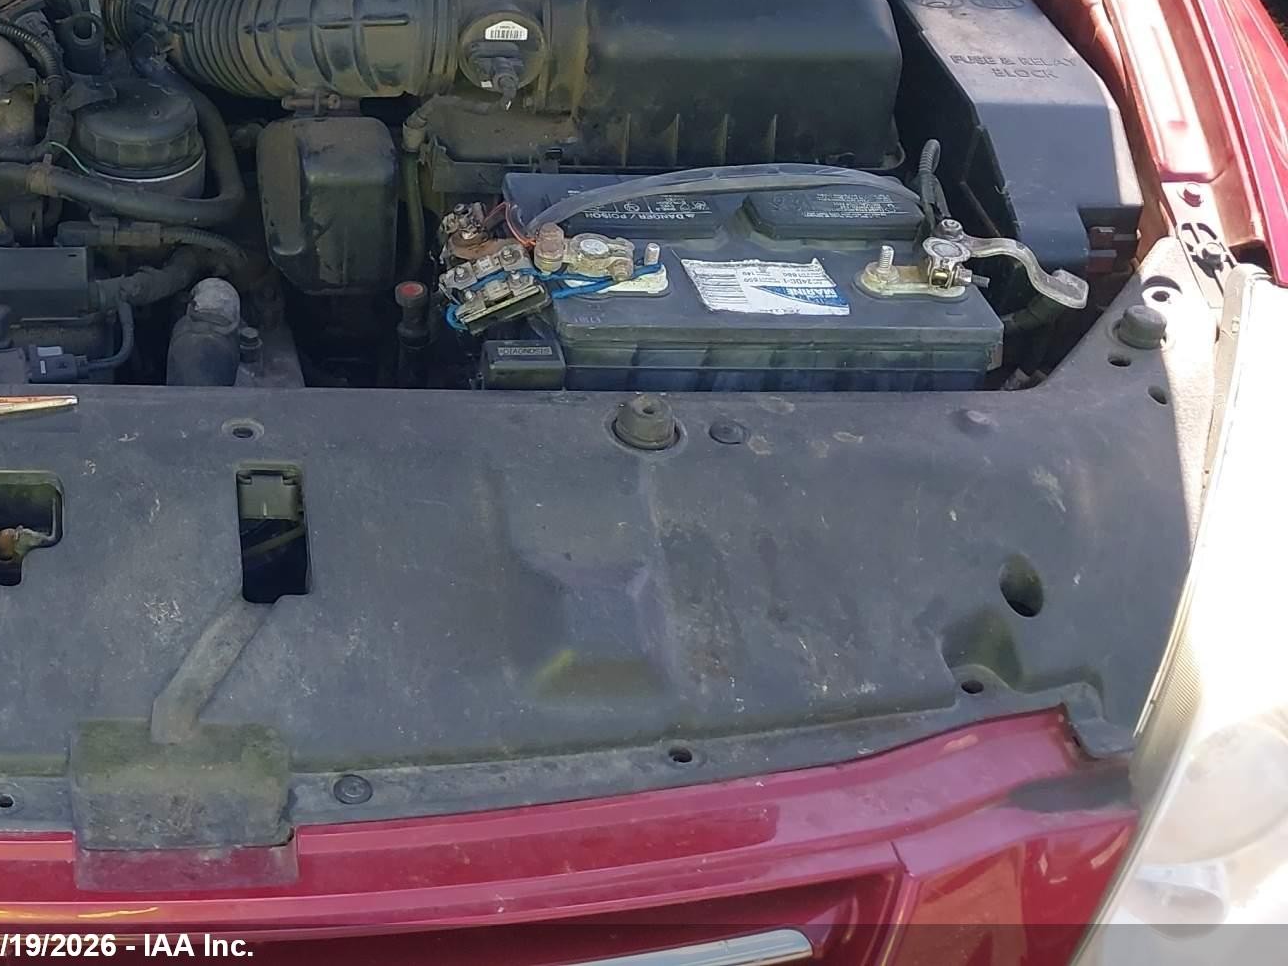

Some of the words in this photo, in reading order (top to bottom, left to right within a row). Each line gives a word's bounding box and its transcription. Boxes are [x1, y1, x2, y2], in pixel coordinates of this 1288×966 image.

[950, 54, 995, 66] FUSE
[1000, 56, 1014, 65] &
[1018, 56, 1076, 67] RELAY
[992, 68, 1058, 79] BLOCK
[786, 287, 839, 299] MARINE
